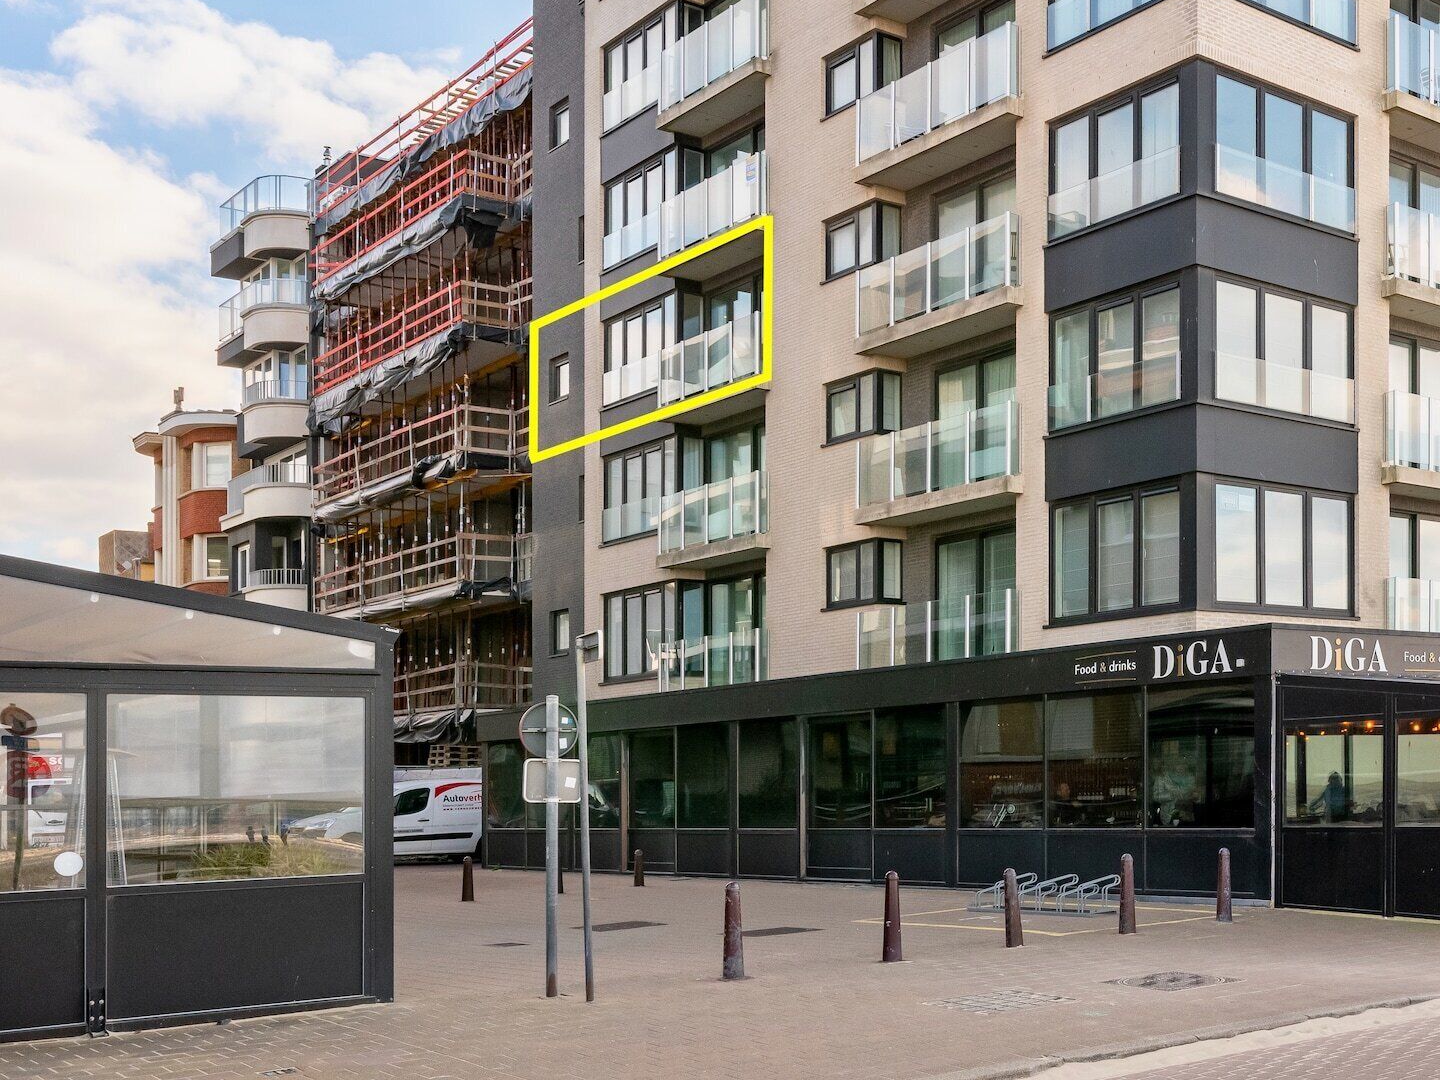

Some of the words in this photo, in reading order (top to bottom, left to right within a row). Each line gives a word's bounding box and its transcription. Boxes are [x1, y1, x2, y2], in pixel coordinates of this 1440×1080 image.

[1310, 635, 1388, 672] DiGA
[1404, 651, 1426, 663] Food
[1429, 652, 1436, 663] &
[1074, 663, 1097, 676] Food
[1100, 662, 1107, 673] &
[1109, 659, 1137, 672] drinks
